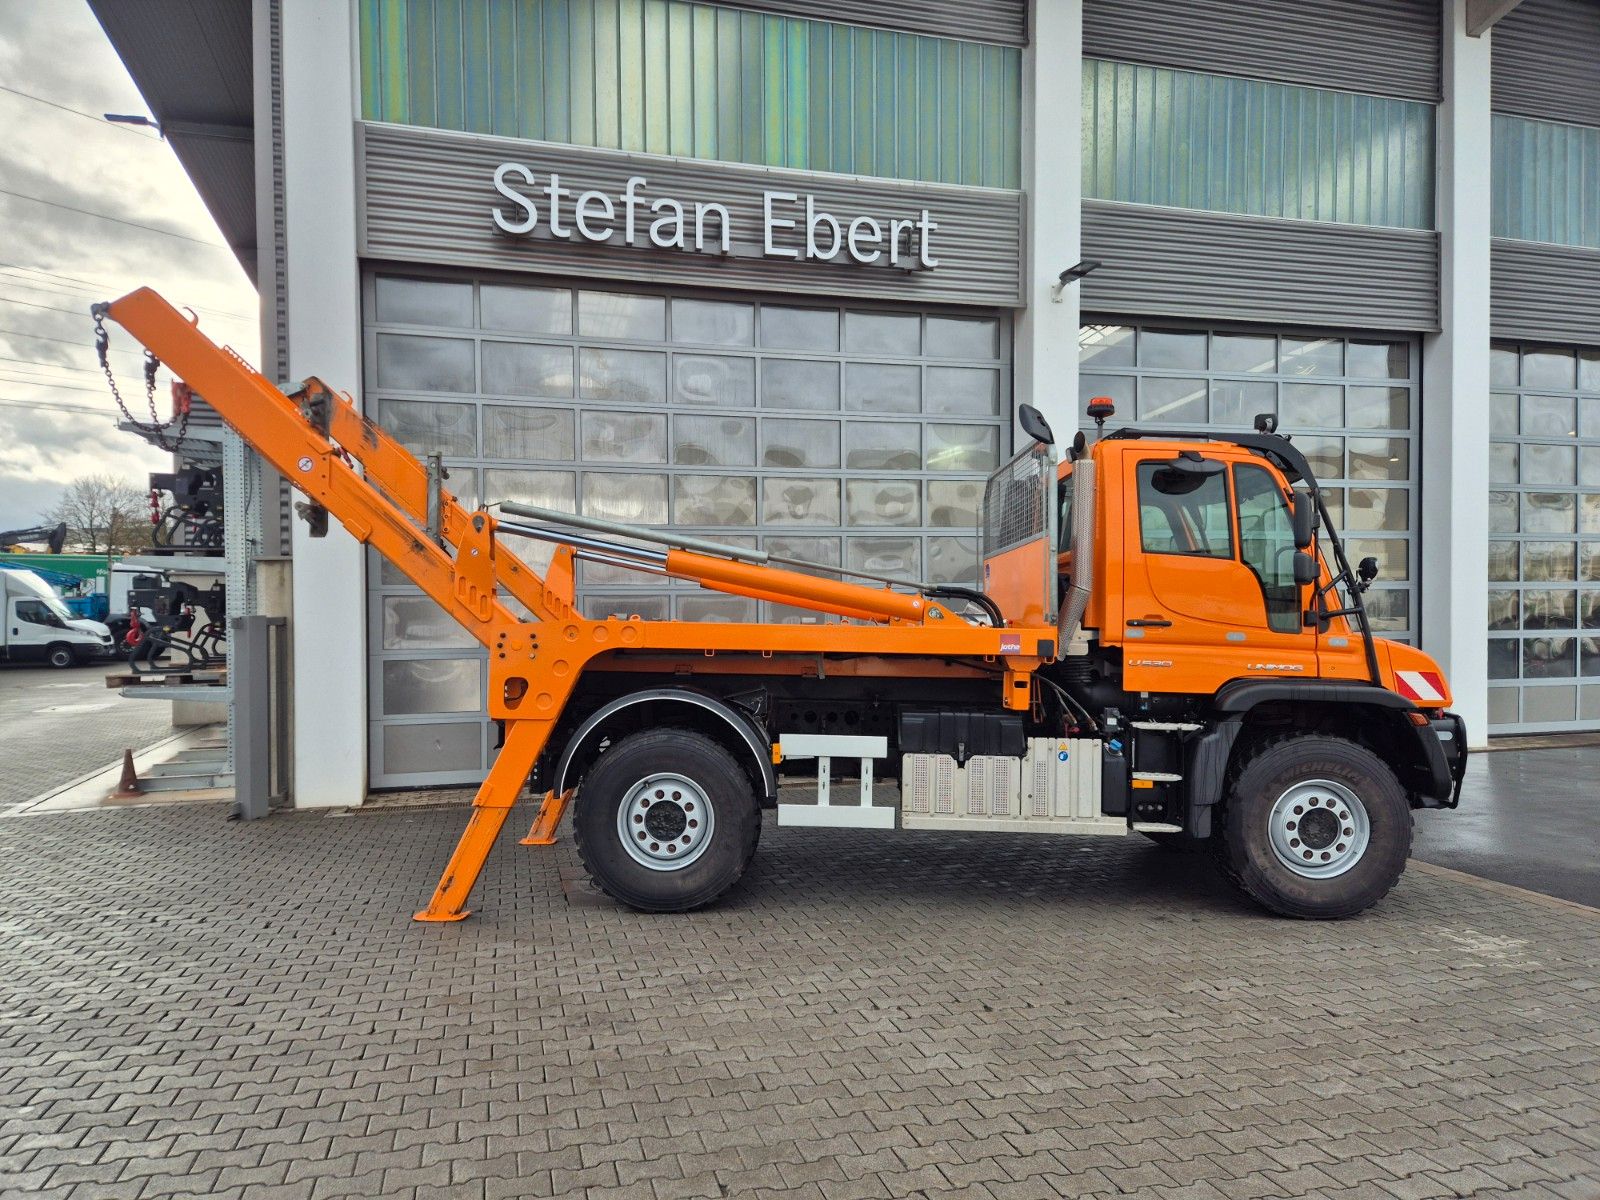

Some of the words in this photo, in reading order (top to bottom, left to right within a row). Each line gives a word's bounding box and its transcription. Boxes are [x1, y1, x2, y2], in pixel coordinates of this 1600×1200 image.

[492, 162, 730, 254] Stefan
[763, 191, 938, 268] Ebert
[1247, 663, 1303, 672] UNIMOG
